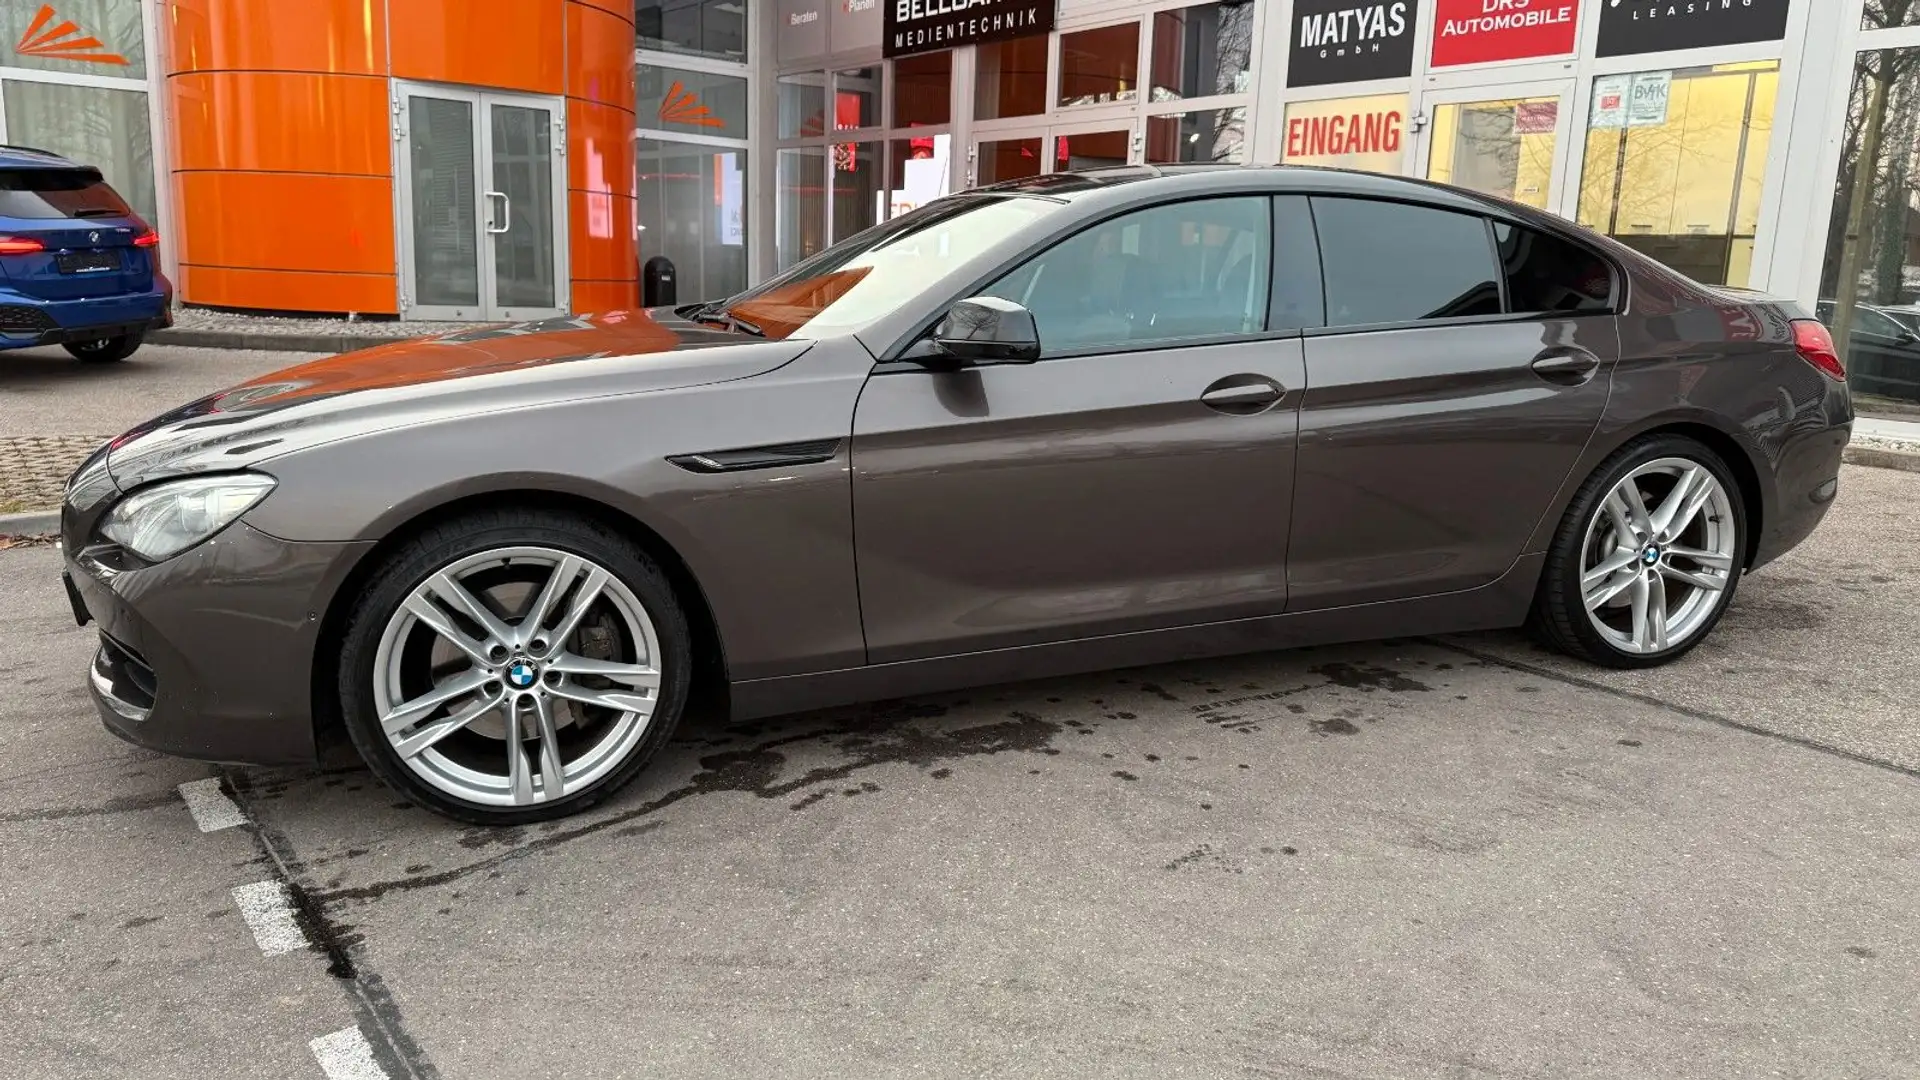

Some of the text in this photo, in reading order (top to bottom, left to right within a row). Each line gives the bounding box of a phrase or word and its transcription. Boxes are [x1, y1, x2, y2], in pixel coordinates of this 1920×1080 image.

[790, 11, 818, 25] Beraten
[1300, 2, 1406, 48] MATYAS
[1441, 6, 1571, 37] AUTOMOBILE
[1633, 0, 1751, 20] LEASING
[895, 8, 1036, 48] MEDIENTECHNIK
[1287, 111, 1401, 157] EINGANG
